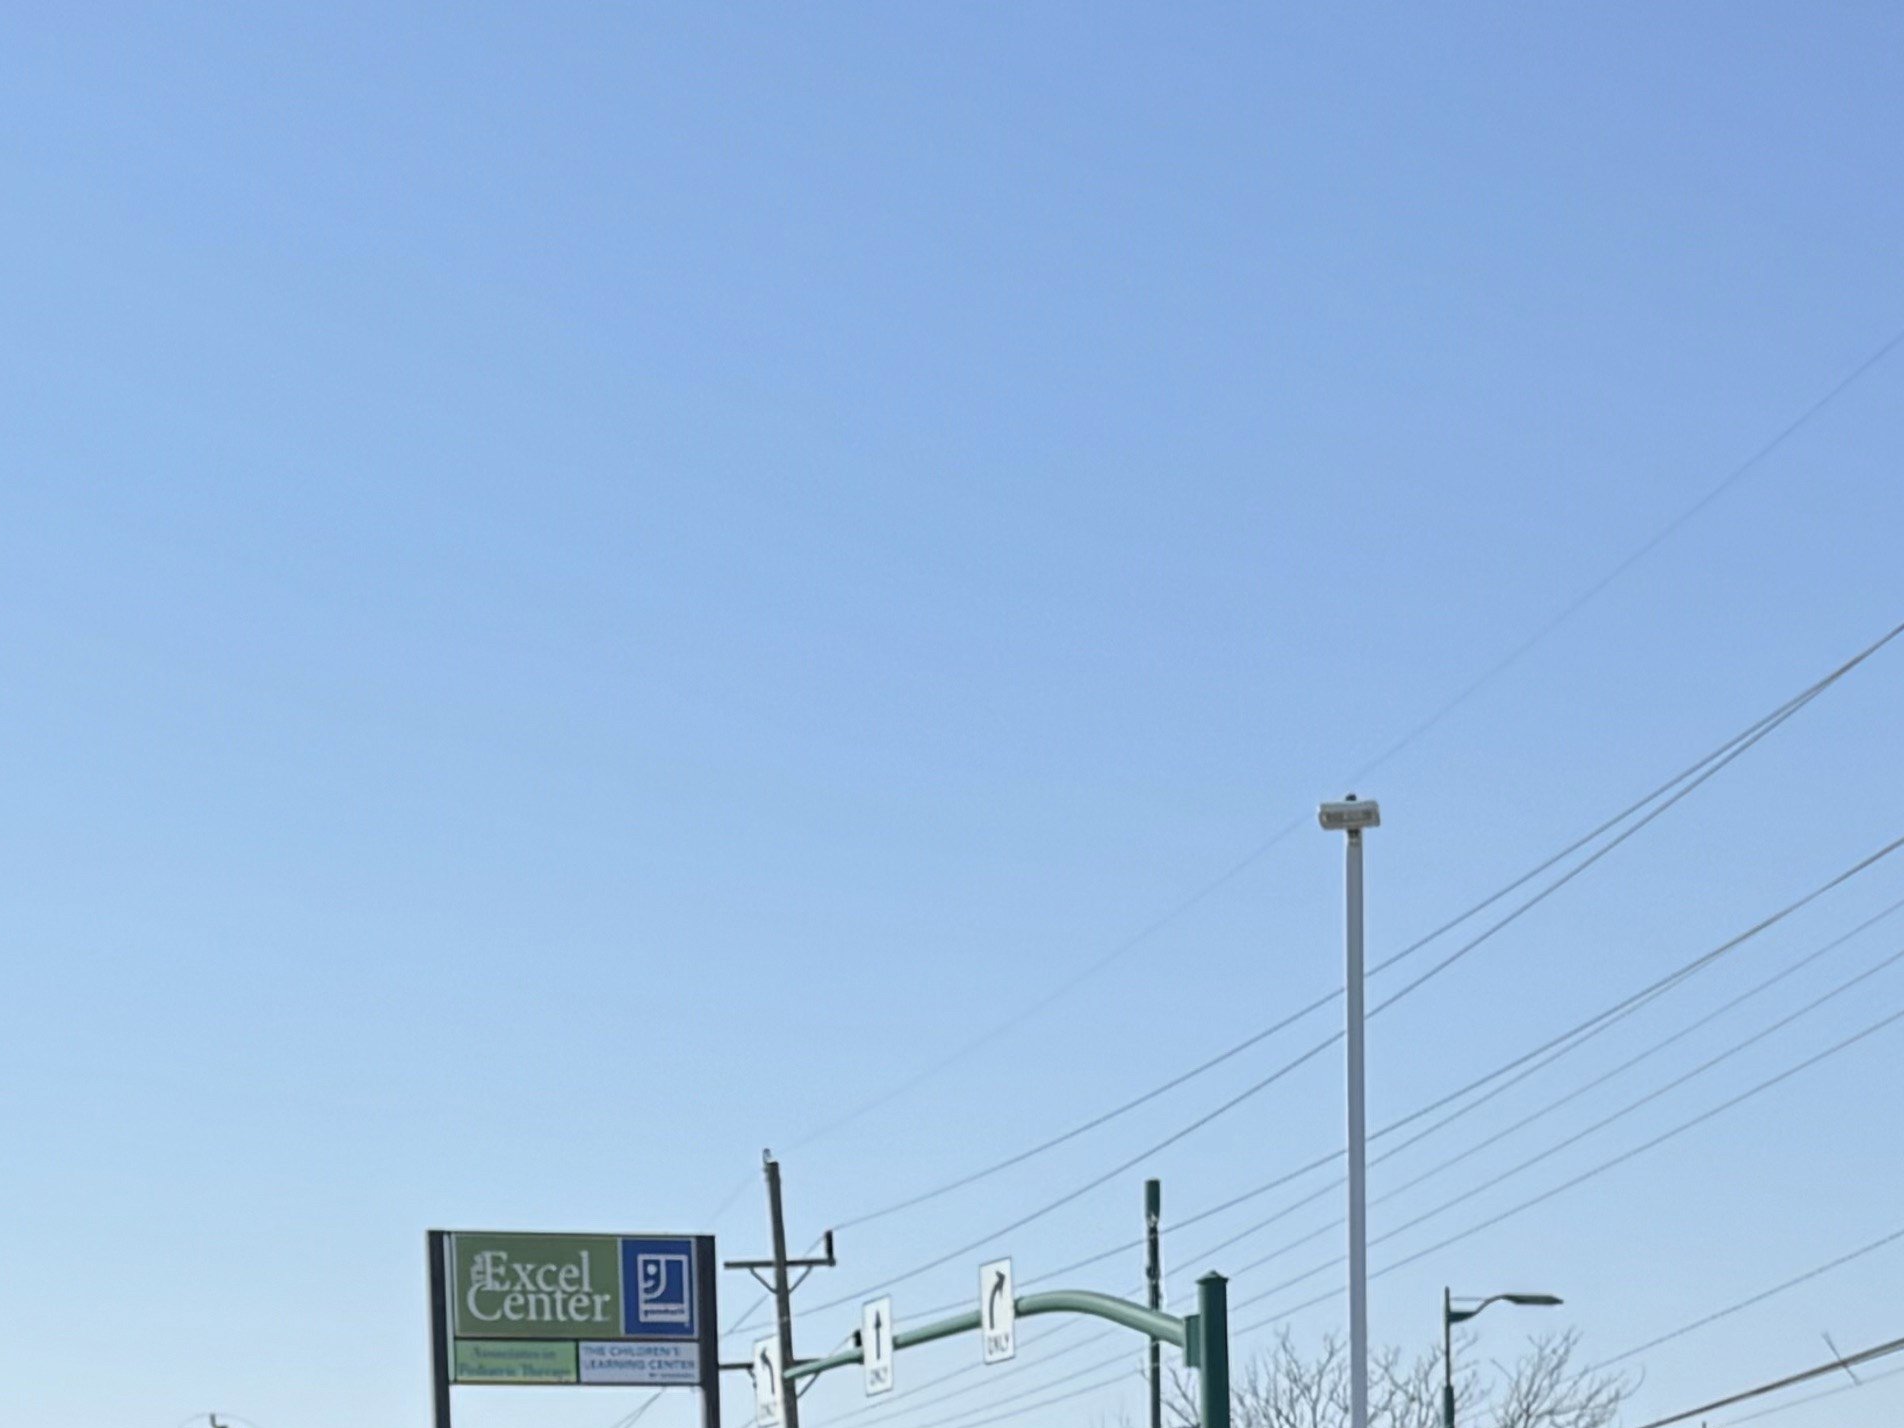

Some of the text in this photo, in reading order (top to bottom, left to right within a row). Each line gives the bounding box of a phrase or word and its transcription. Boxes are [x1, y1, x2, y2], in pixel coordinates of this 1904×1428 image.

[481, 1250, 593, 1292] Excel
[467, 1281, 611, 1321] Center
[649, 1359, 695, 1370] CENTER
